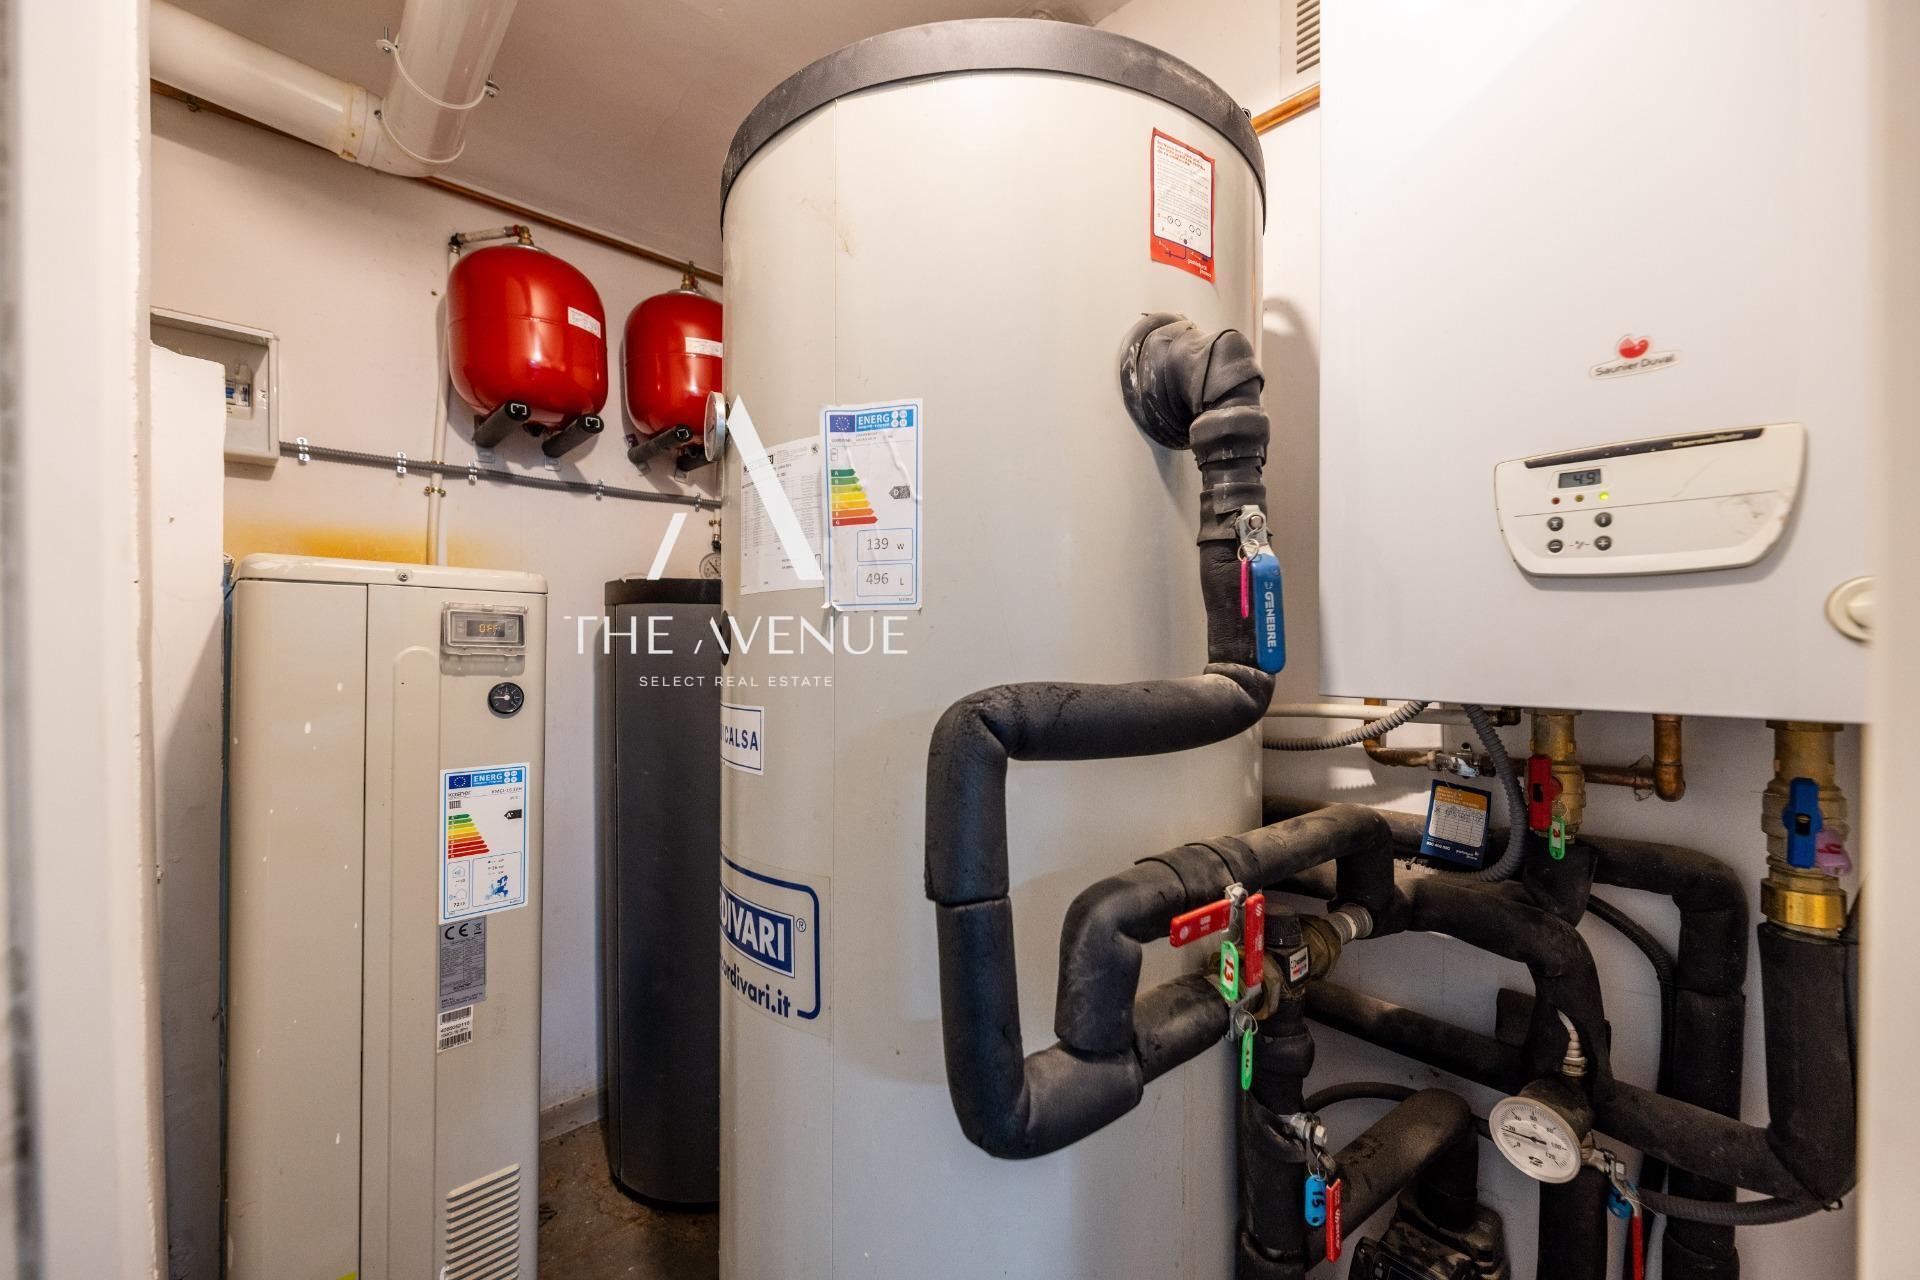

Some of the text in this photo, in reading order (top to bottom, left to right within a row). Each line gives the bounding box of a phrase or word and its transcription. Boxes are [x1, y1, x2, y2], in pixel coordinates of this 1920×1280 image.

[1595, 362, 1638, 375] Saunier
[858, 413, 890, 426] ENERG
[1573, 473, 1596, 485] 49
[866, 538, 889, 551] 139
[866, 573, 904, 586] 496 L
[1264, 591, 1277, 648] GENEBRE
[480, 624, 497, 633] OFF
[474, 772, 503, 783] ENERG
[720, 886, 785, 962] DIVARI
[444, 923, 469, 940] CE
[1224, 959, 1234, 982] 13
[1312, 1191, 1325, 1208] 15
